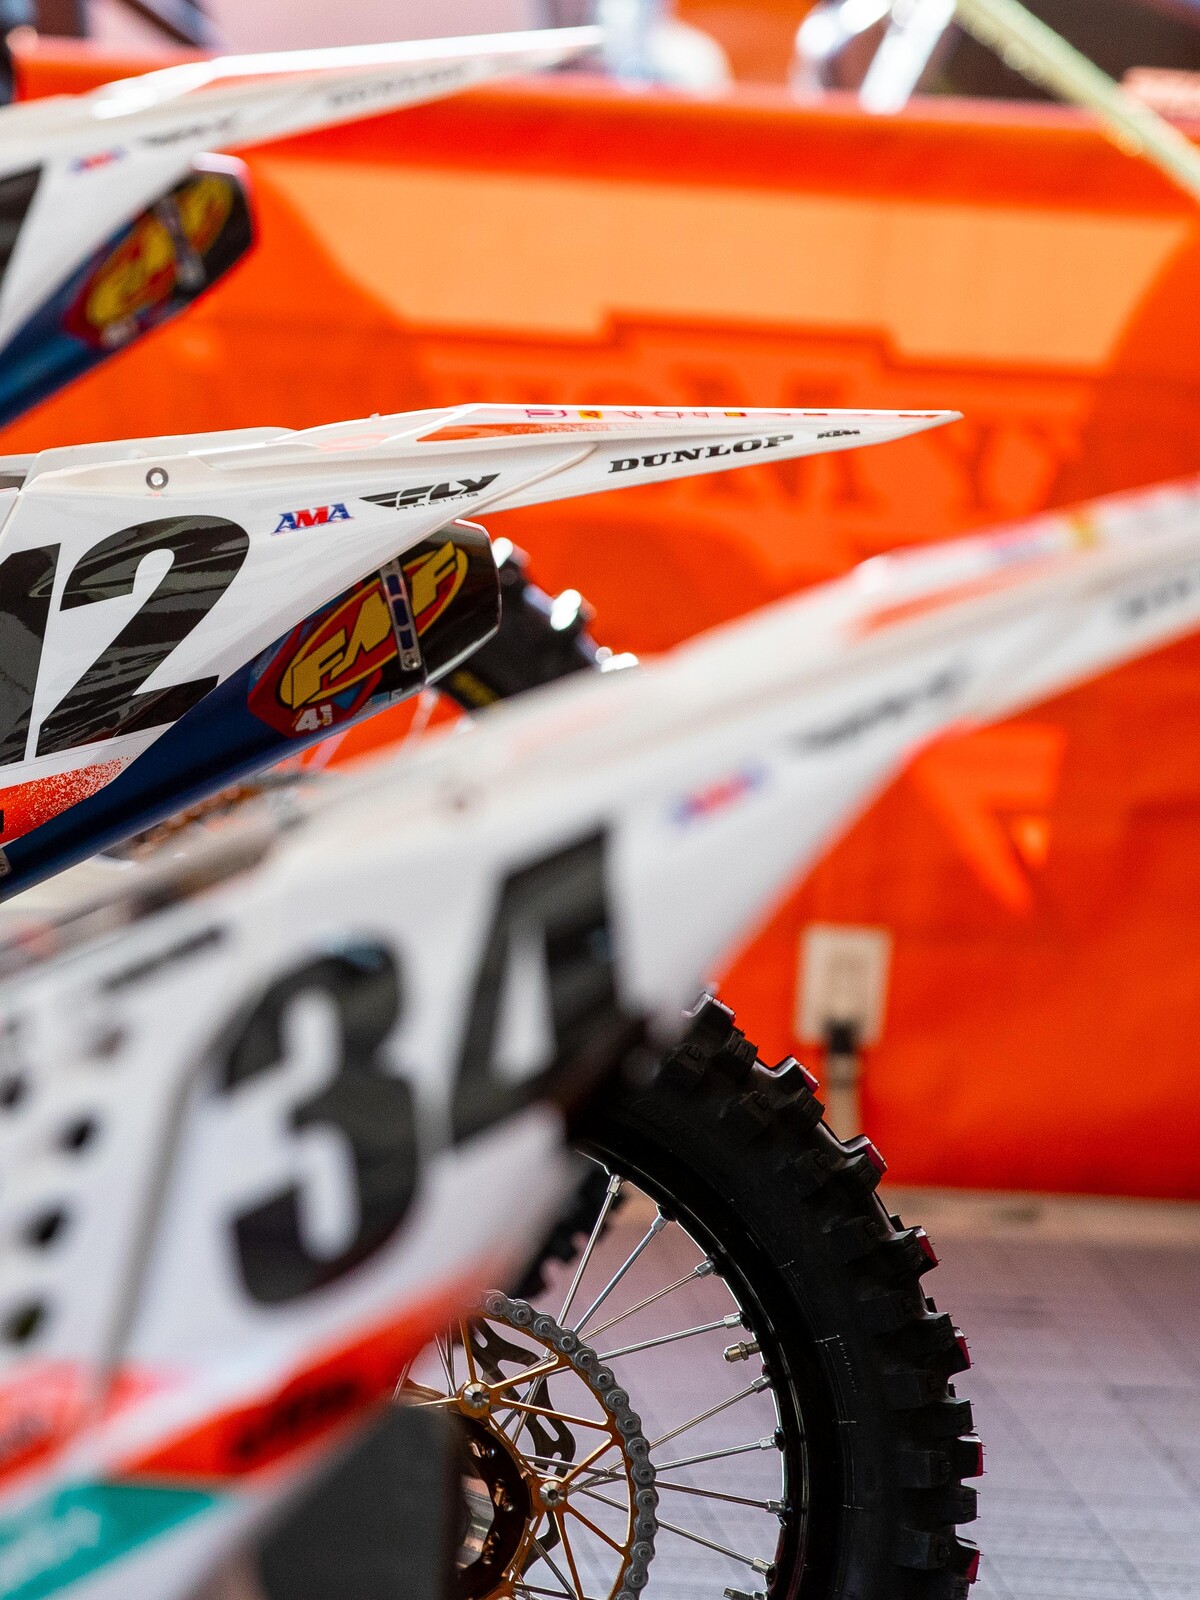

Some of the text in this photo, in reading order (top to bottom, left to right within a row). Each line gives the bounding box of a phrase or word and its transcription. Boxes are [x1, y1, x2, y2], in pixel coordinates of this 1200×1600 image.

[608, 433, 794, 474] DUNLOP
[358, 472, 501, 508] FLY
[396, 492, 480, 511] RACING
[270, 502, 355, 536] AMA
[222, 820, 634, 1312] 34
